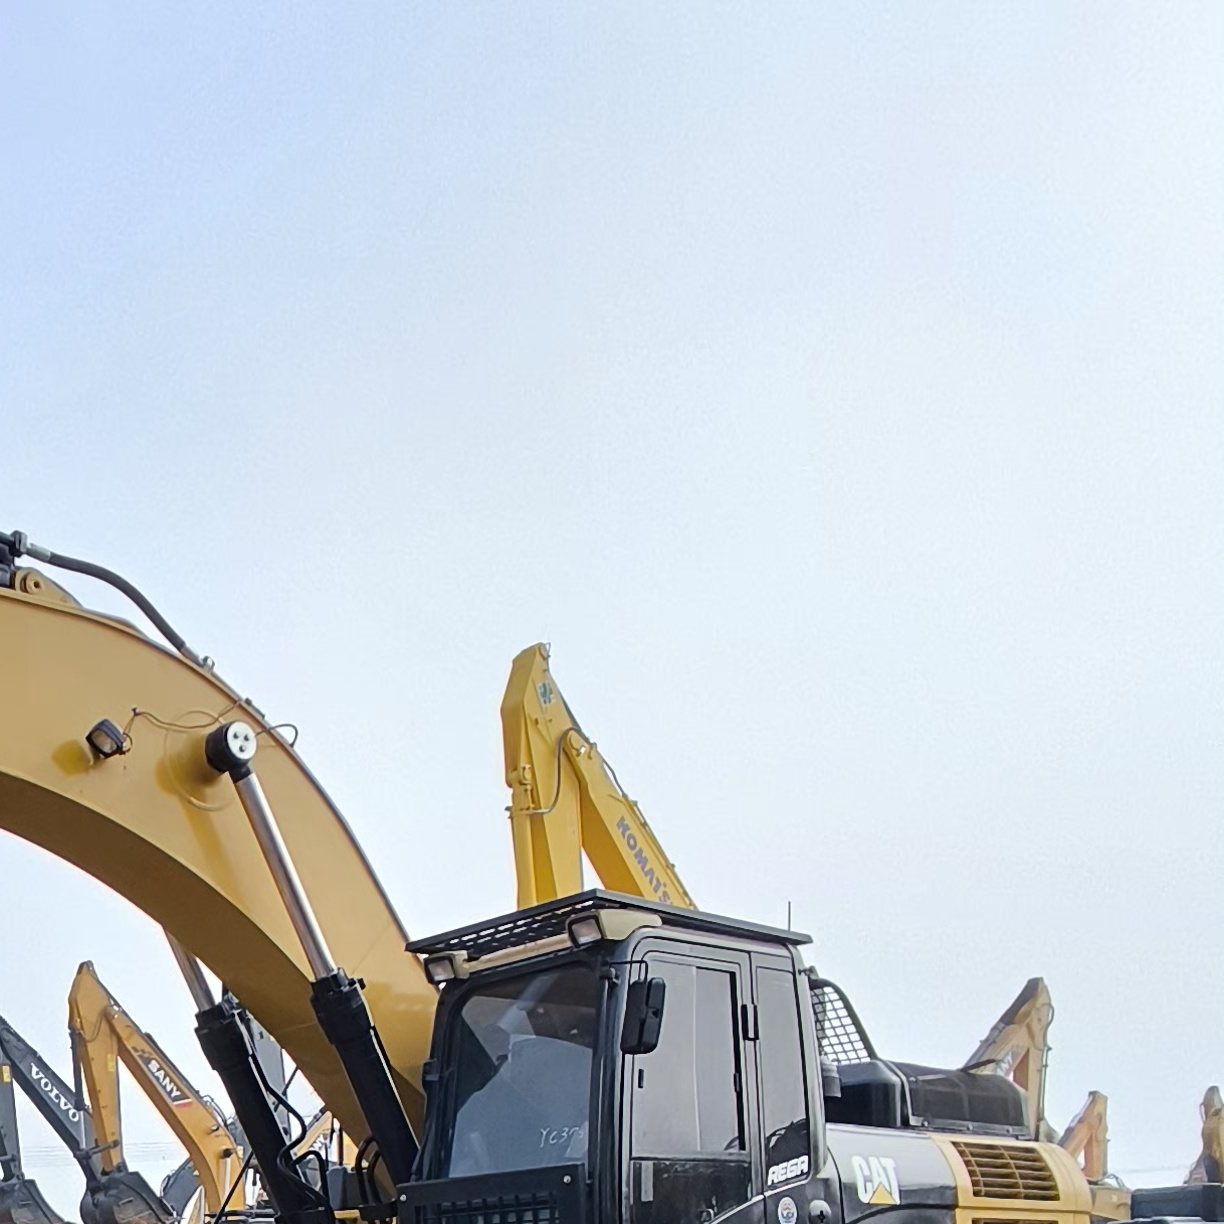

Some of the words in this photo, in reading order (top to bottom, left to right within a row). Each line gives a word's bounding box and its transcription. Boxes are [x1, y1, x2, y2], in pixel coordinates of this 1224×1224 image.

[616, 816, 674, 904] KOMATS
[30, 1063, 80, 1122] VOLVO
[147, 1059, 181, 1098] SANY
[851, 1156, 900, 1205] CAT
